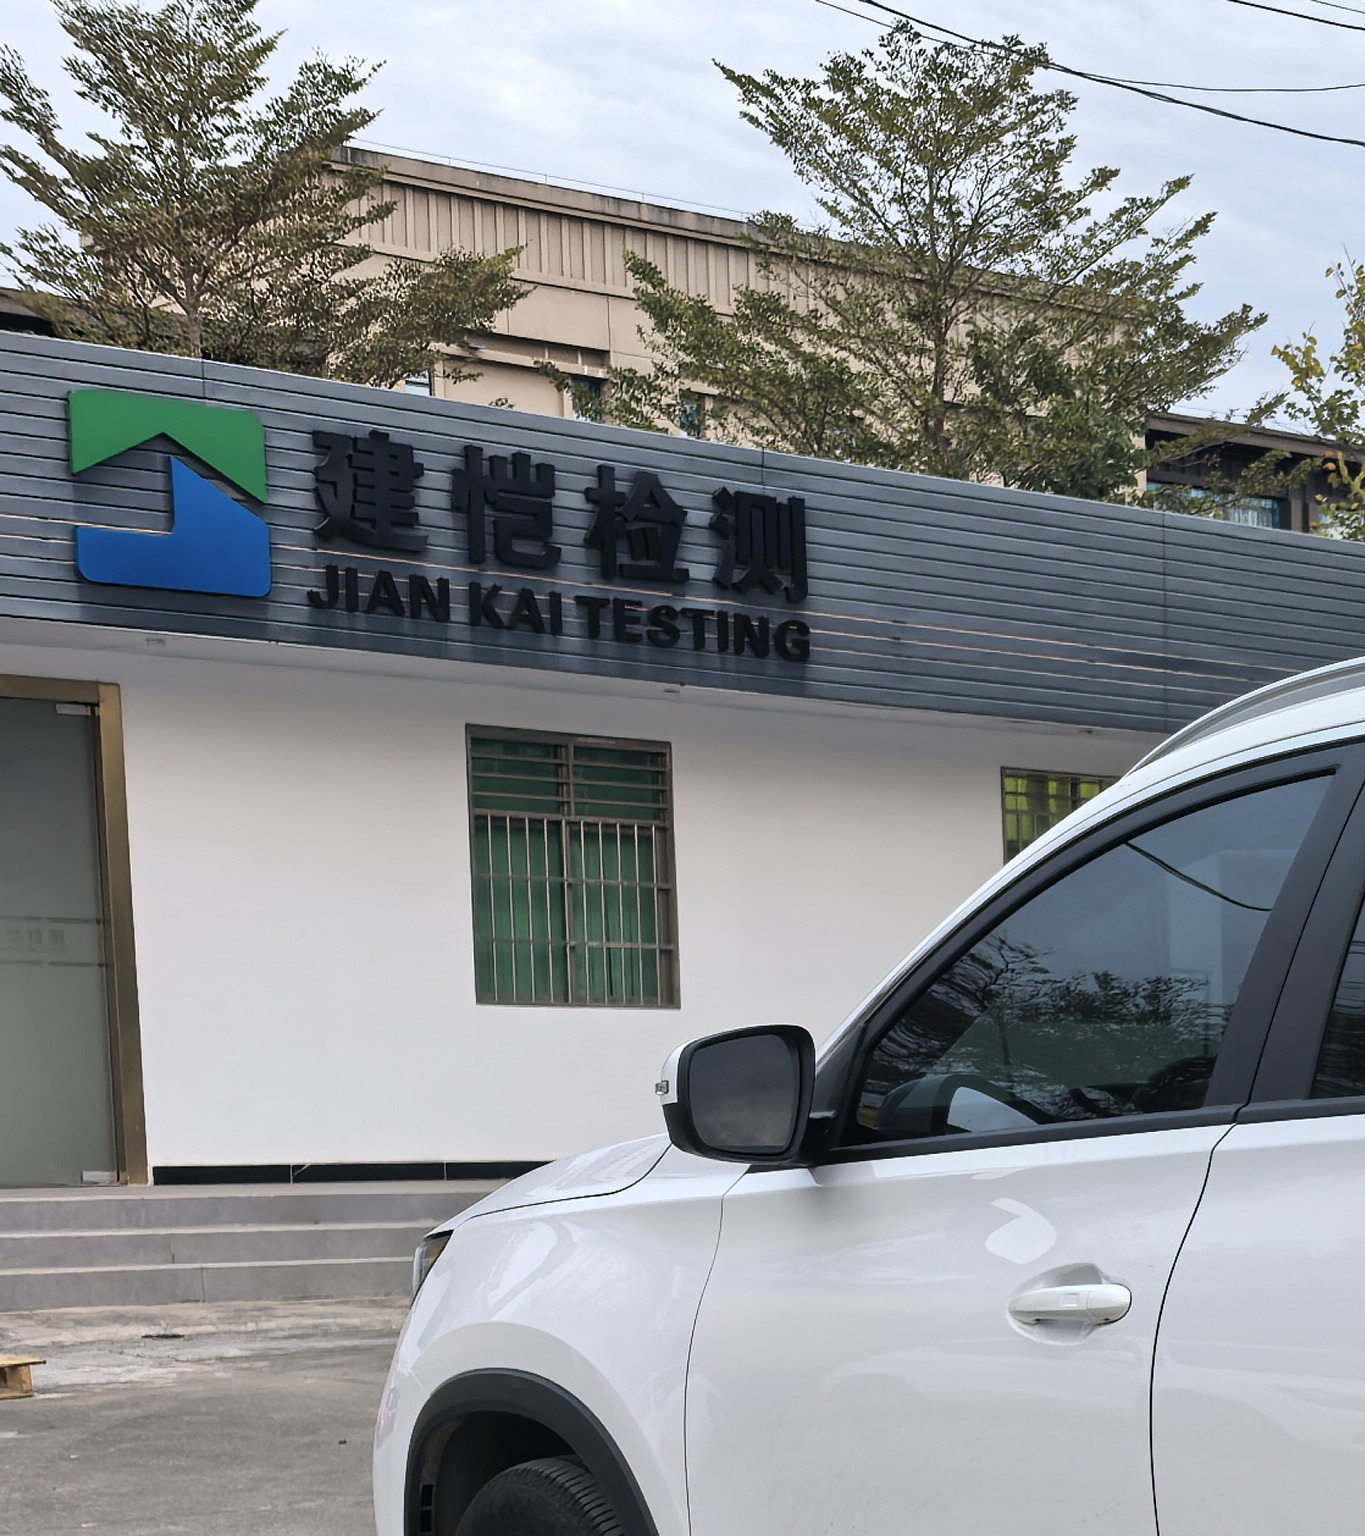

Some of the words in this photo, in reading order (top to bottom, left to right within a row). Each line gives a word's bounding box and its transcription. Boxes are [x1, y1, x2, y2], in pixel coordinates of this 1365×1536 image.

[311, 429, 808, 602] 建恺检测
[307, 563, 450, 624] JIAN
[469, 580, 563, 636] KAI
[576, 595, 811, 662] TESTING
